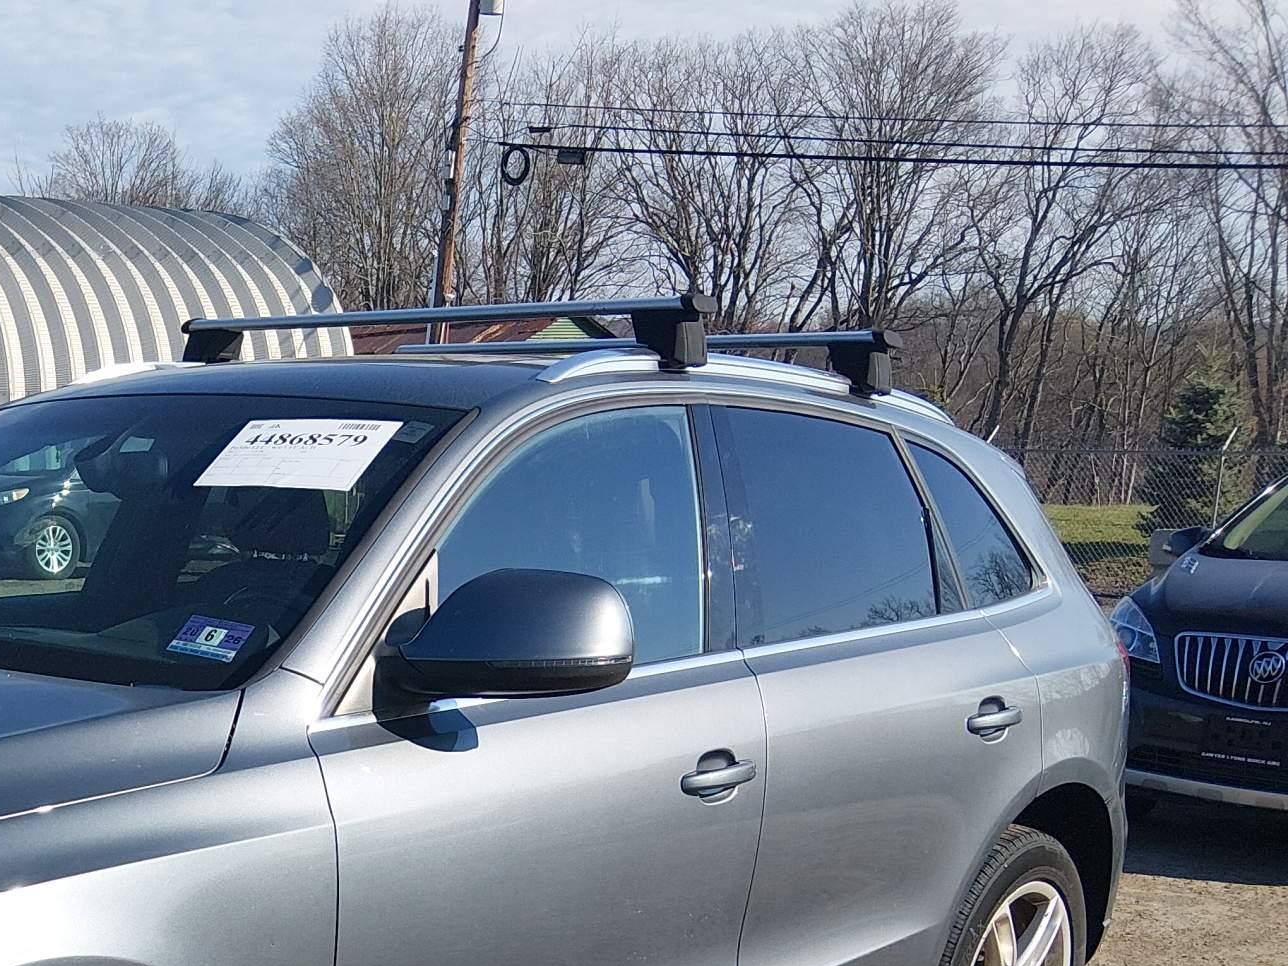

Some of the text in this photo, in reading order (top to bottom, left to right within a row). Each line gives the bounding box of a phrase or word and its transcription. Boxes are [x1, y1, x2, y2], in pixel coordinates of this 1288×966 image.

[245, 432, 369, 447] 44868579
[204, 629, 217, 642] 6
[224, 635, 243, 645] 26
